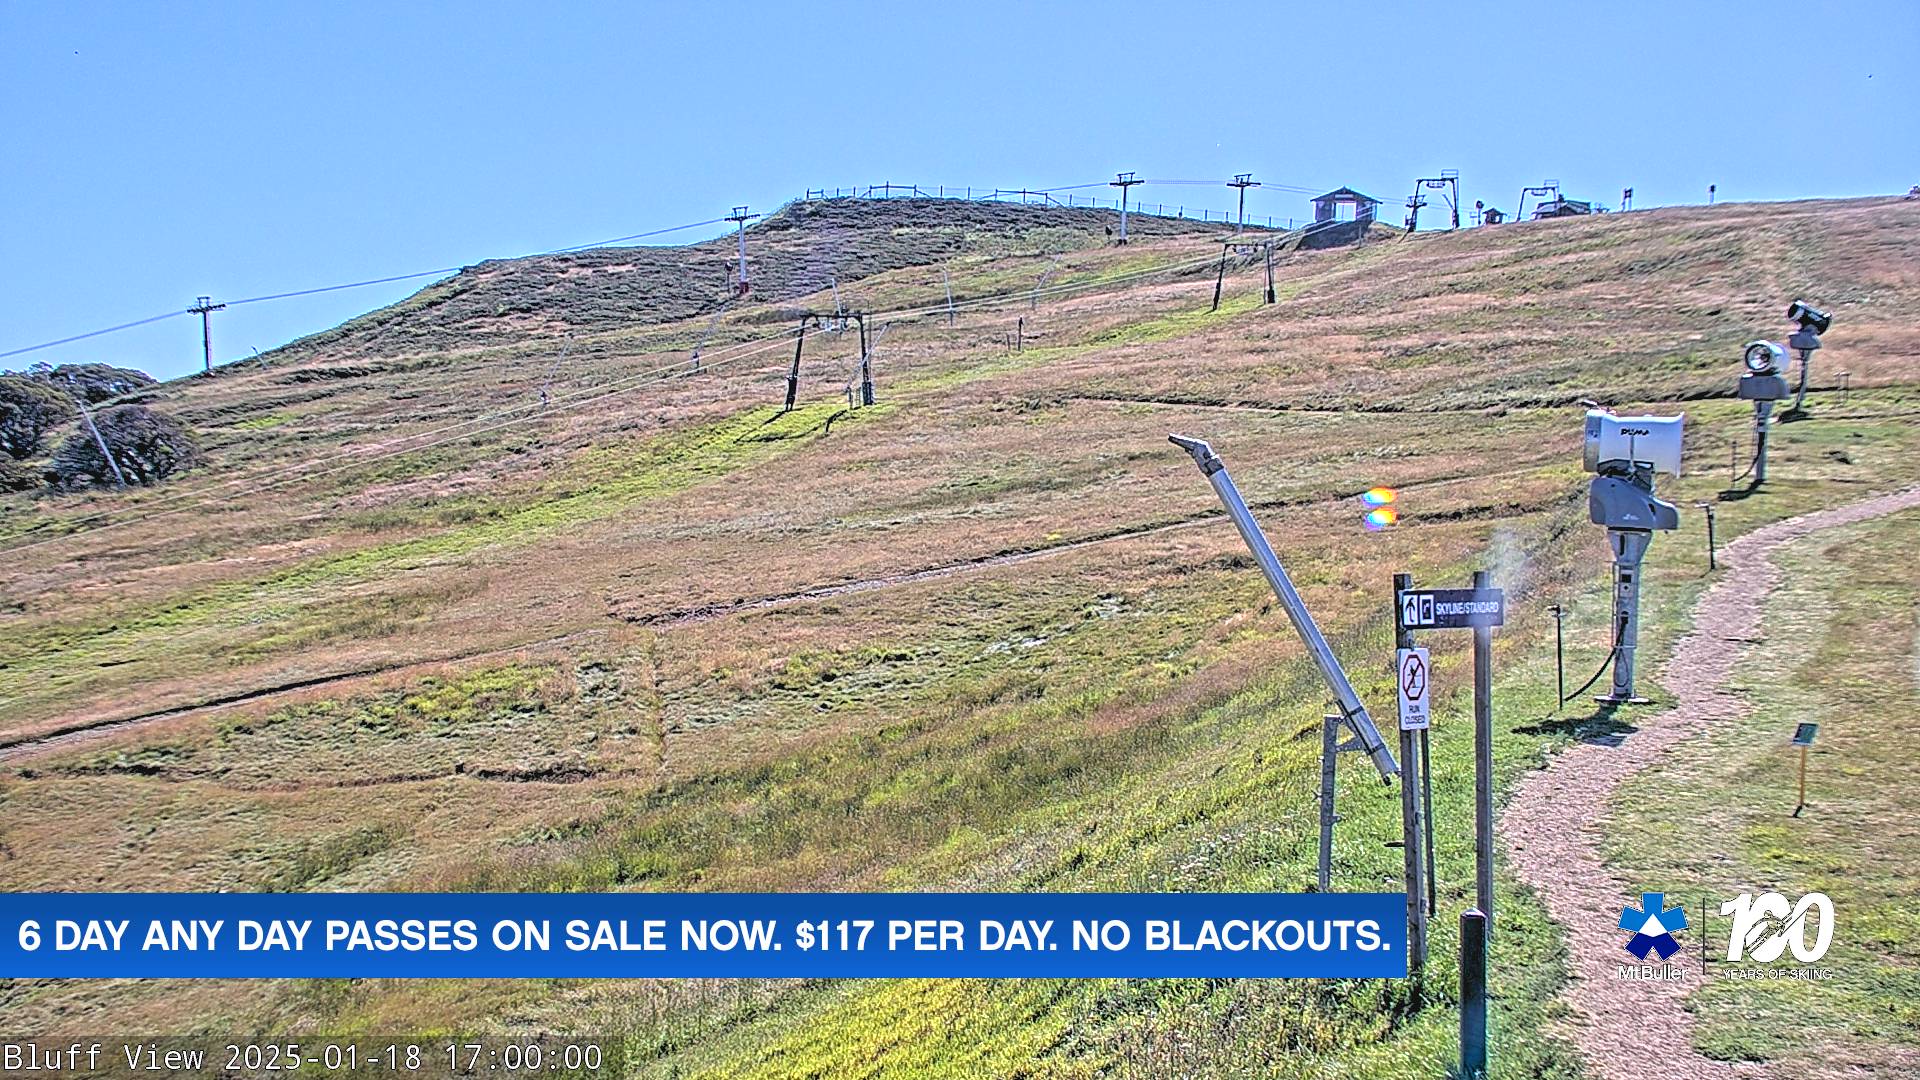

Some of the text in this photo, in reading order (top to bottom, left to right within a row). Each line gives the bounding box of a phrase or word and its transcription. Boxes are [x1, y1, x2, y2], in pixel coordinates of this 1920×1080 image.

[1436, 602, 1499, 616] SKYLINE/STANDARD
[1408, 704, 1420, 714] RUN
[1405, 715, 1425, 725] CLOSED
